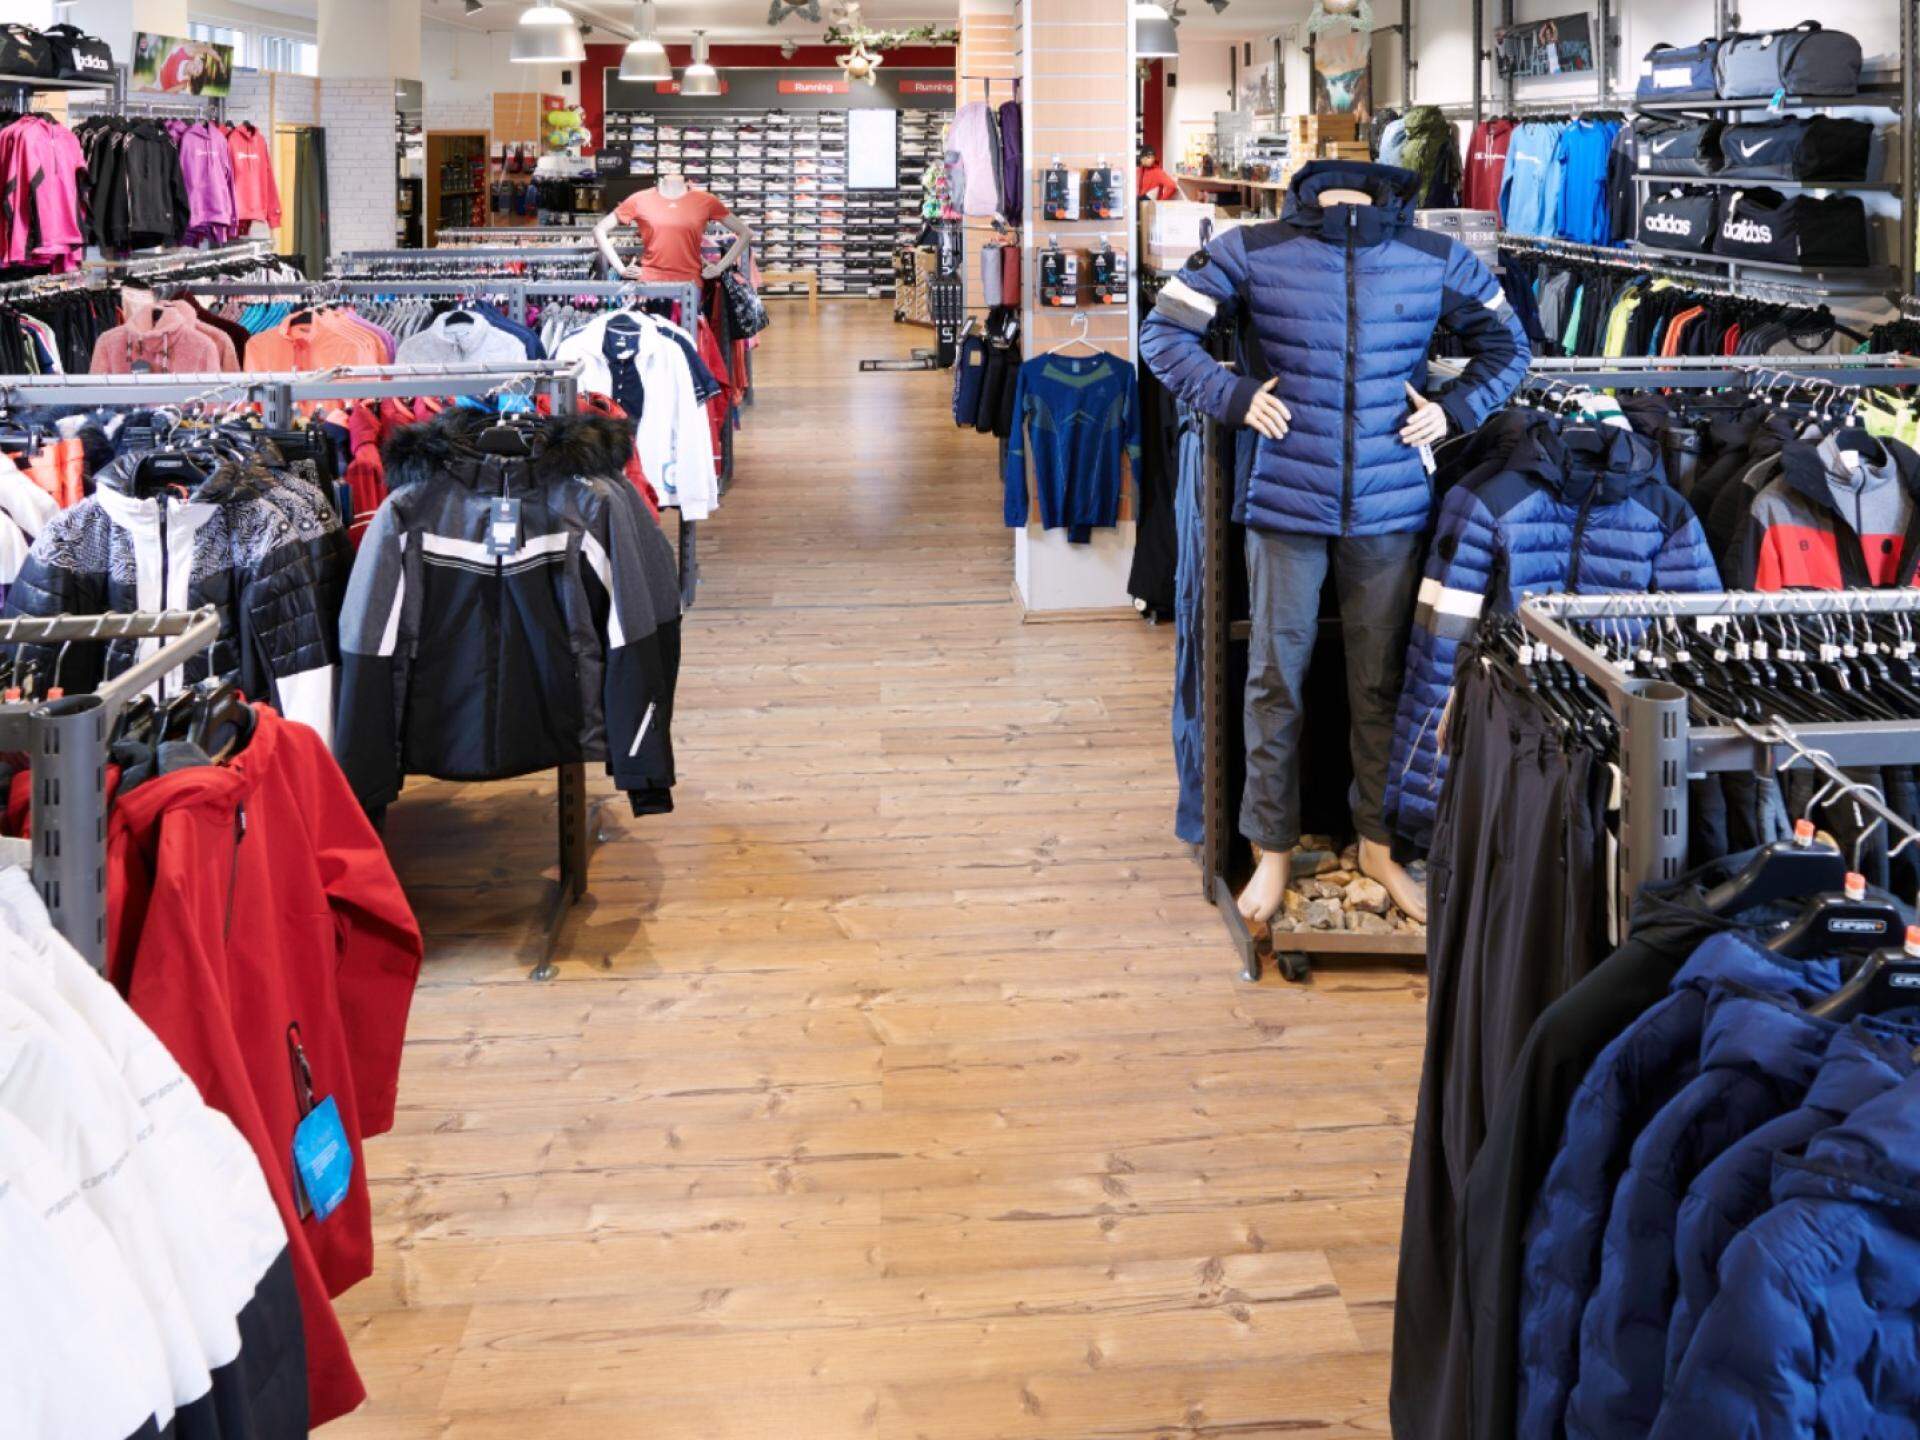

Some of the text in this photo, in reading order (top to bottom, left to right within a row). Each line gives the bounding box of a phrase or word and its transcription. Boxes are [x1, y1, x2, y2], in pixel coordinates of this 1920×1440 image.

[794, 82, 834, 94] Running
[915, 82, 953, 94] Running
[1645, 212, 1691, 236] adidas
